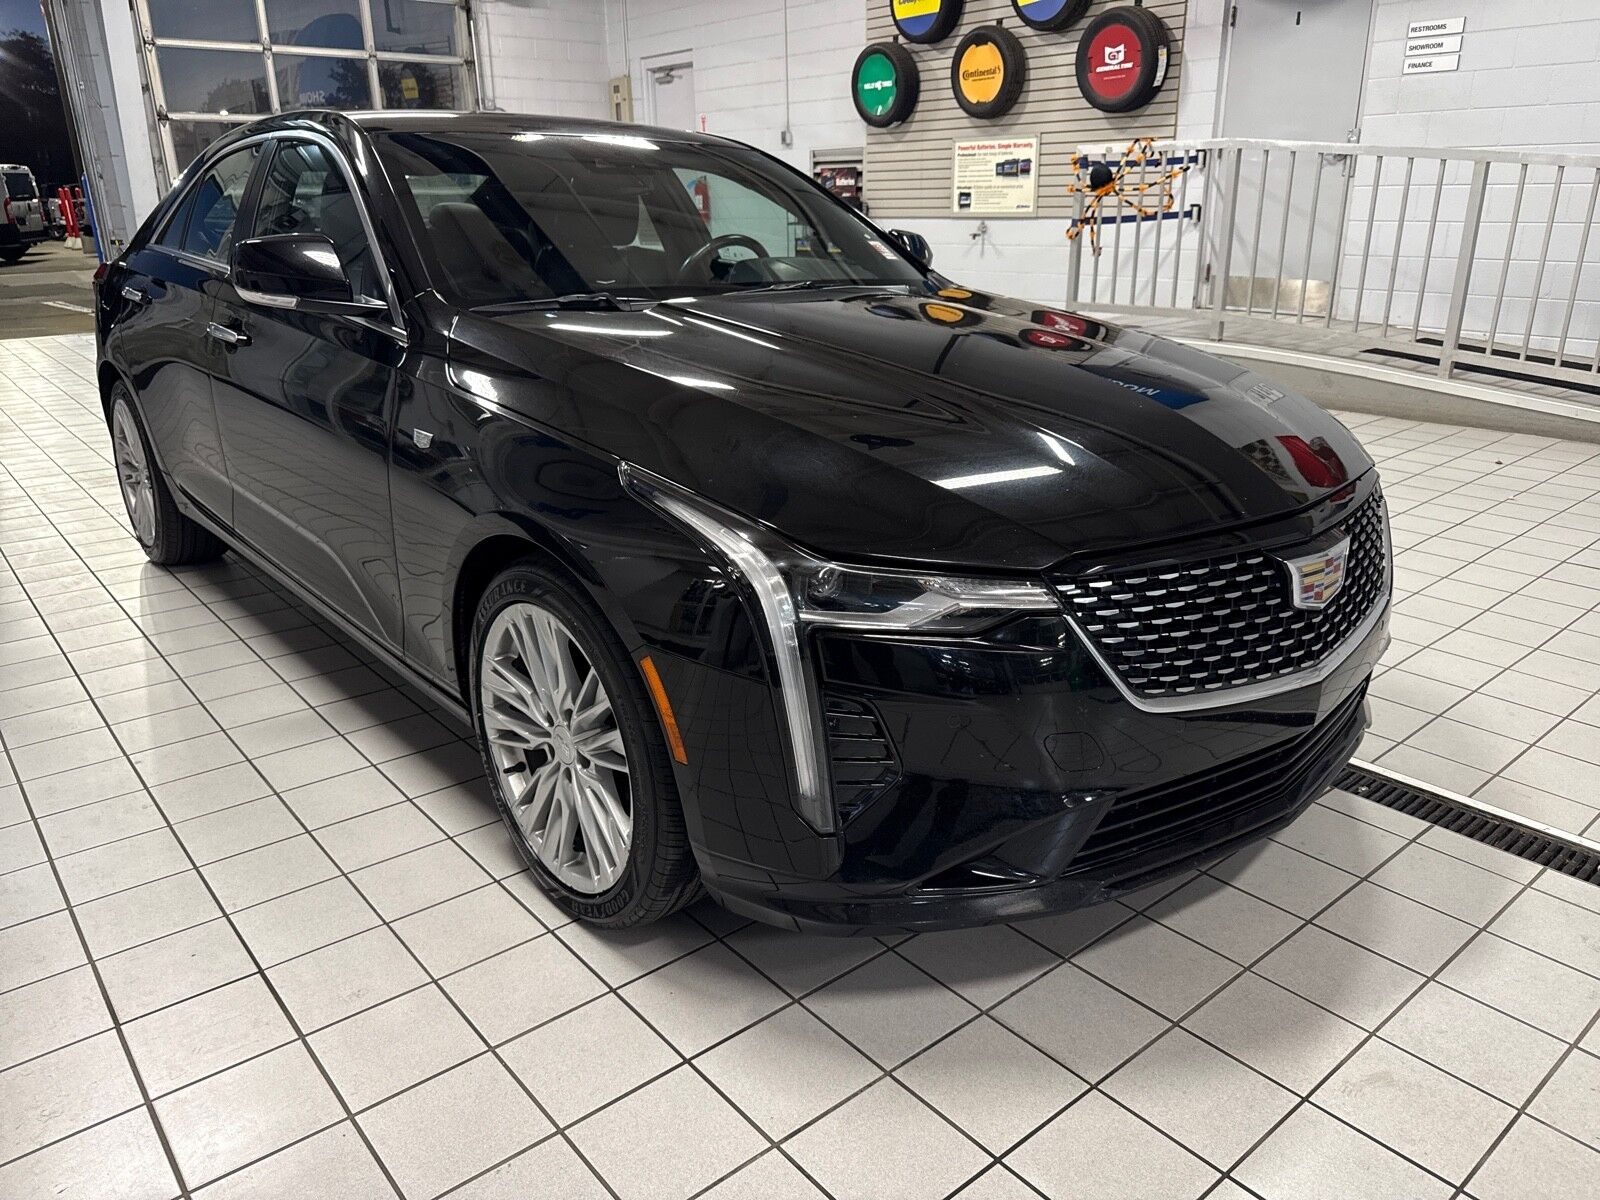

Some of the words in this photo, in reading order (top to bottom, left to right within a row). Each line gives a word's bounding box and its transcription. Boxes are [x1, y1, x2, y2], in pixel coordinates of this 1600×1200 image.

[1410, 23, 1447, 32] RESTROOMS
[1408, 42, 1443, 51] SHOWROOM
[1108, 50, 1122, 61] GT
[1095, 64, 1121, 73] GENERAL
[1408, 61, 1433, 69] FINANCE
[962, 66, 997, 80] Continental
[478, 579, 527, 622] ASSURANCE
[571, 889, 630, 918] GOODYEAR
